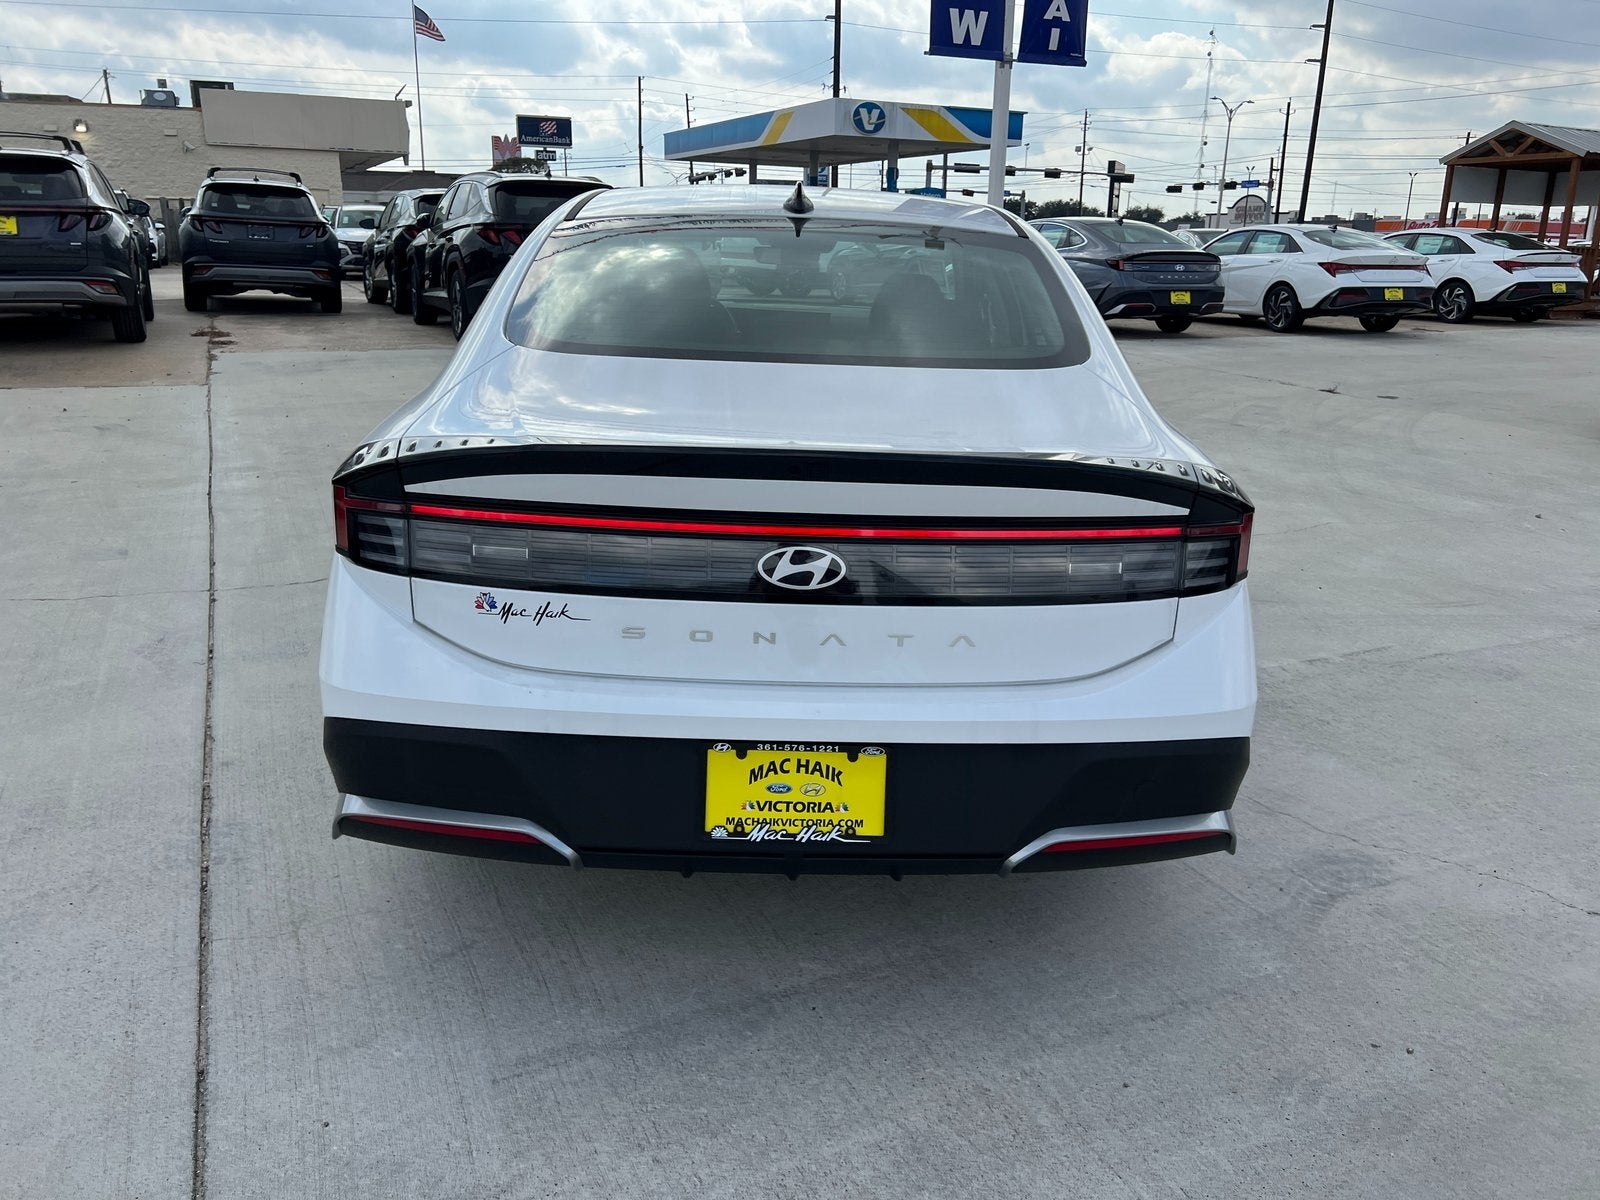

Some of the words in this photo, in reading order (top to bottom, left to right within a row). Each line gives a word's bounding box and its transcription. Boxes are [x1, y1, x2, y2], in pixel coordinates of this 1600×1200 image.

[520, 134, 571, 144] AmericanBank
[537, 150, 556, 160] atm
[499, 602, 532, 624] Mac
[532, 601, 584, 626] Haik
[621, 625, 976, 648] SONATA
[756, 743, 840, 753] 361-576-1221
[748, 757, 791, 786] MAC
[796, 759, 843, 787] HAIK
[755, 800, 835, 814] VICTORIA
[725, 816, 865, 829] MACHAIKVICTORIA.COM
[748, 822, 794, 843] Mac
[795, 825, 856, 843] Haik
